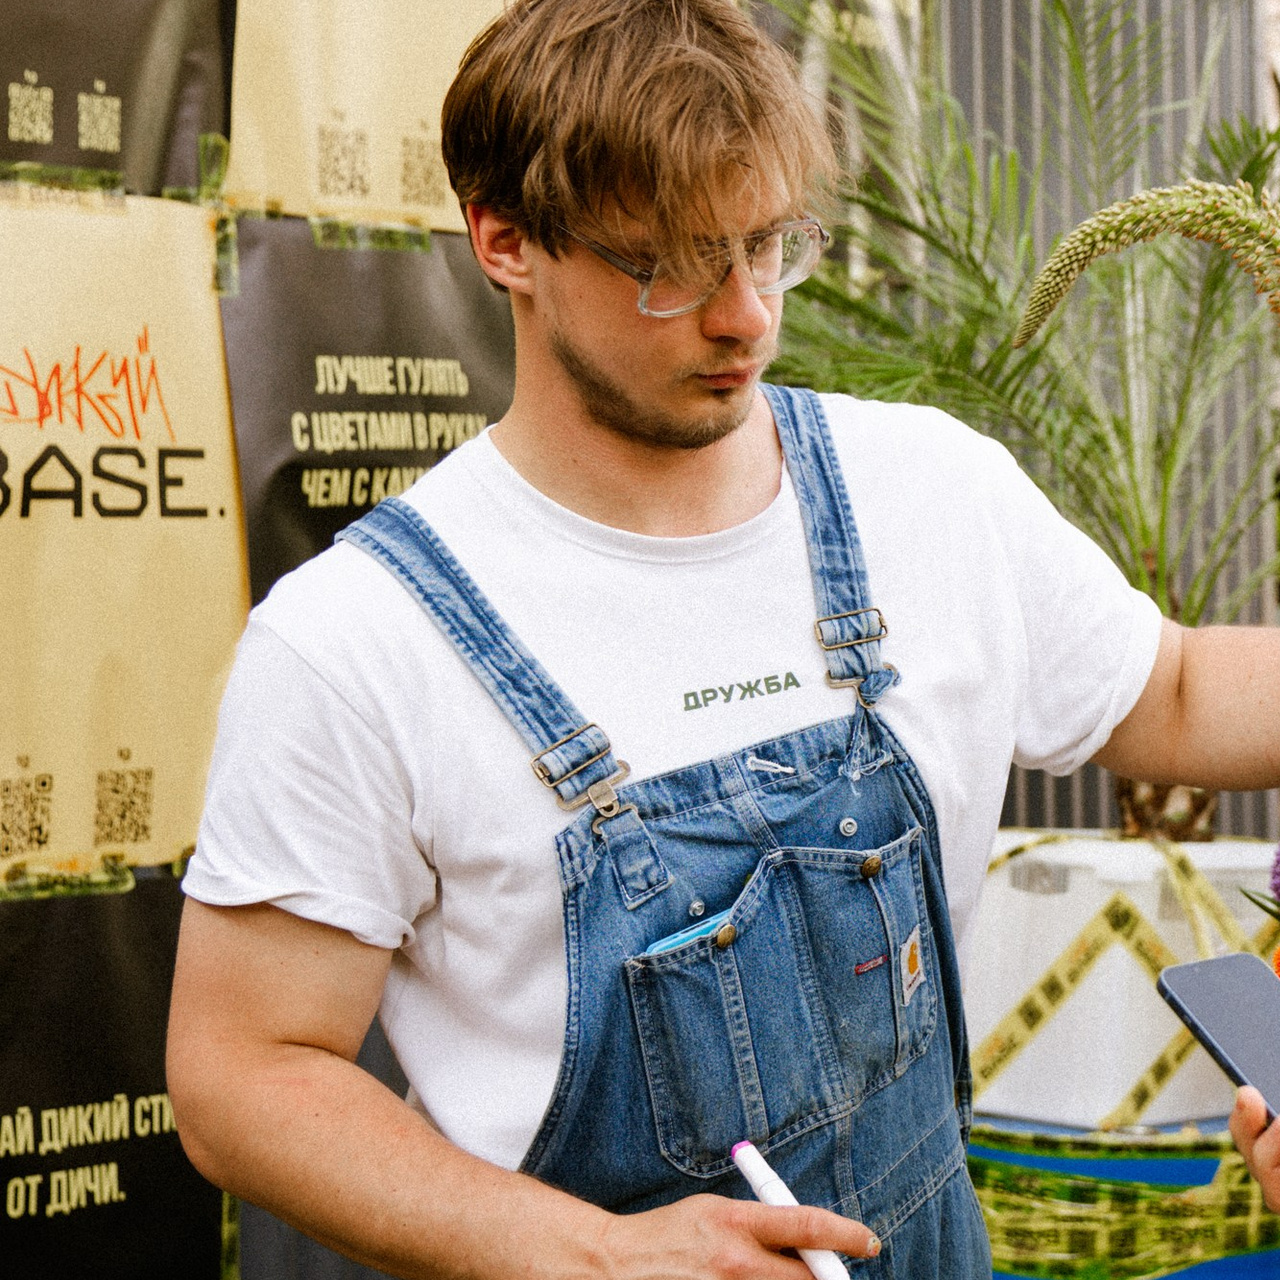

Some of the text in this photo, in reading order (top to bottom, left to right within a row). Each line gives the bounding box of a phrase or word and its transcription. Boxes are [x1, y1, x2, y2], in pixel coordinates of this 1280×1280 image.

[315, 354, 470, 397] ЛУЧШЕ ГУЛЯТЬ
[291, 411, 311, 452] С
[310, 411, 414, 455] ЦВЕТАМИ
[412, 412, 430, 451] В
[0, 443, 226, 518] ASE.
[301, 467, 351, 507] ЧЕМ
[352, 467, 370, 506] С
[683, 671, 802, 712] ДРУЖБА
[39, 1093, 130, 1156] ДИКИЙ
[6, 1161, 127, 1219] ОТ ДИЧИ.
